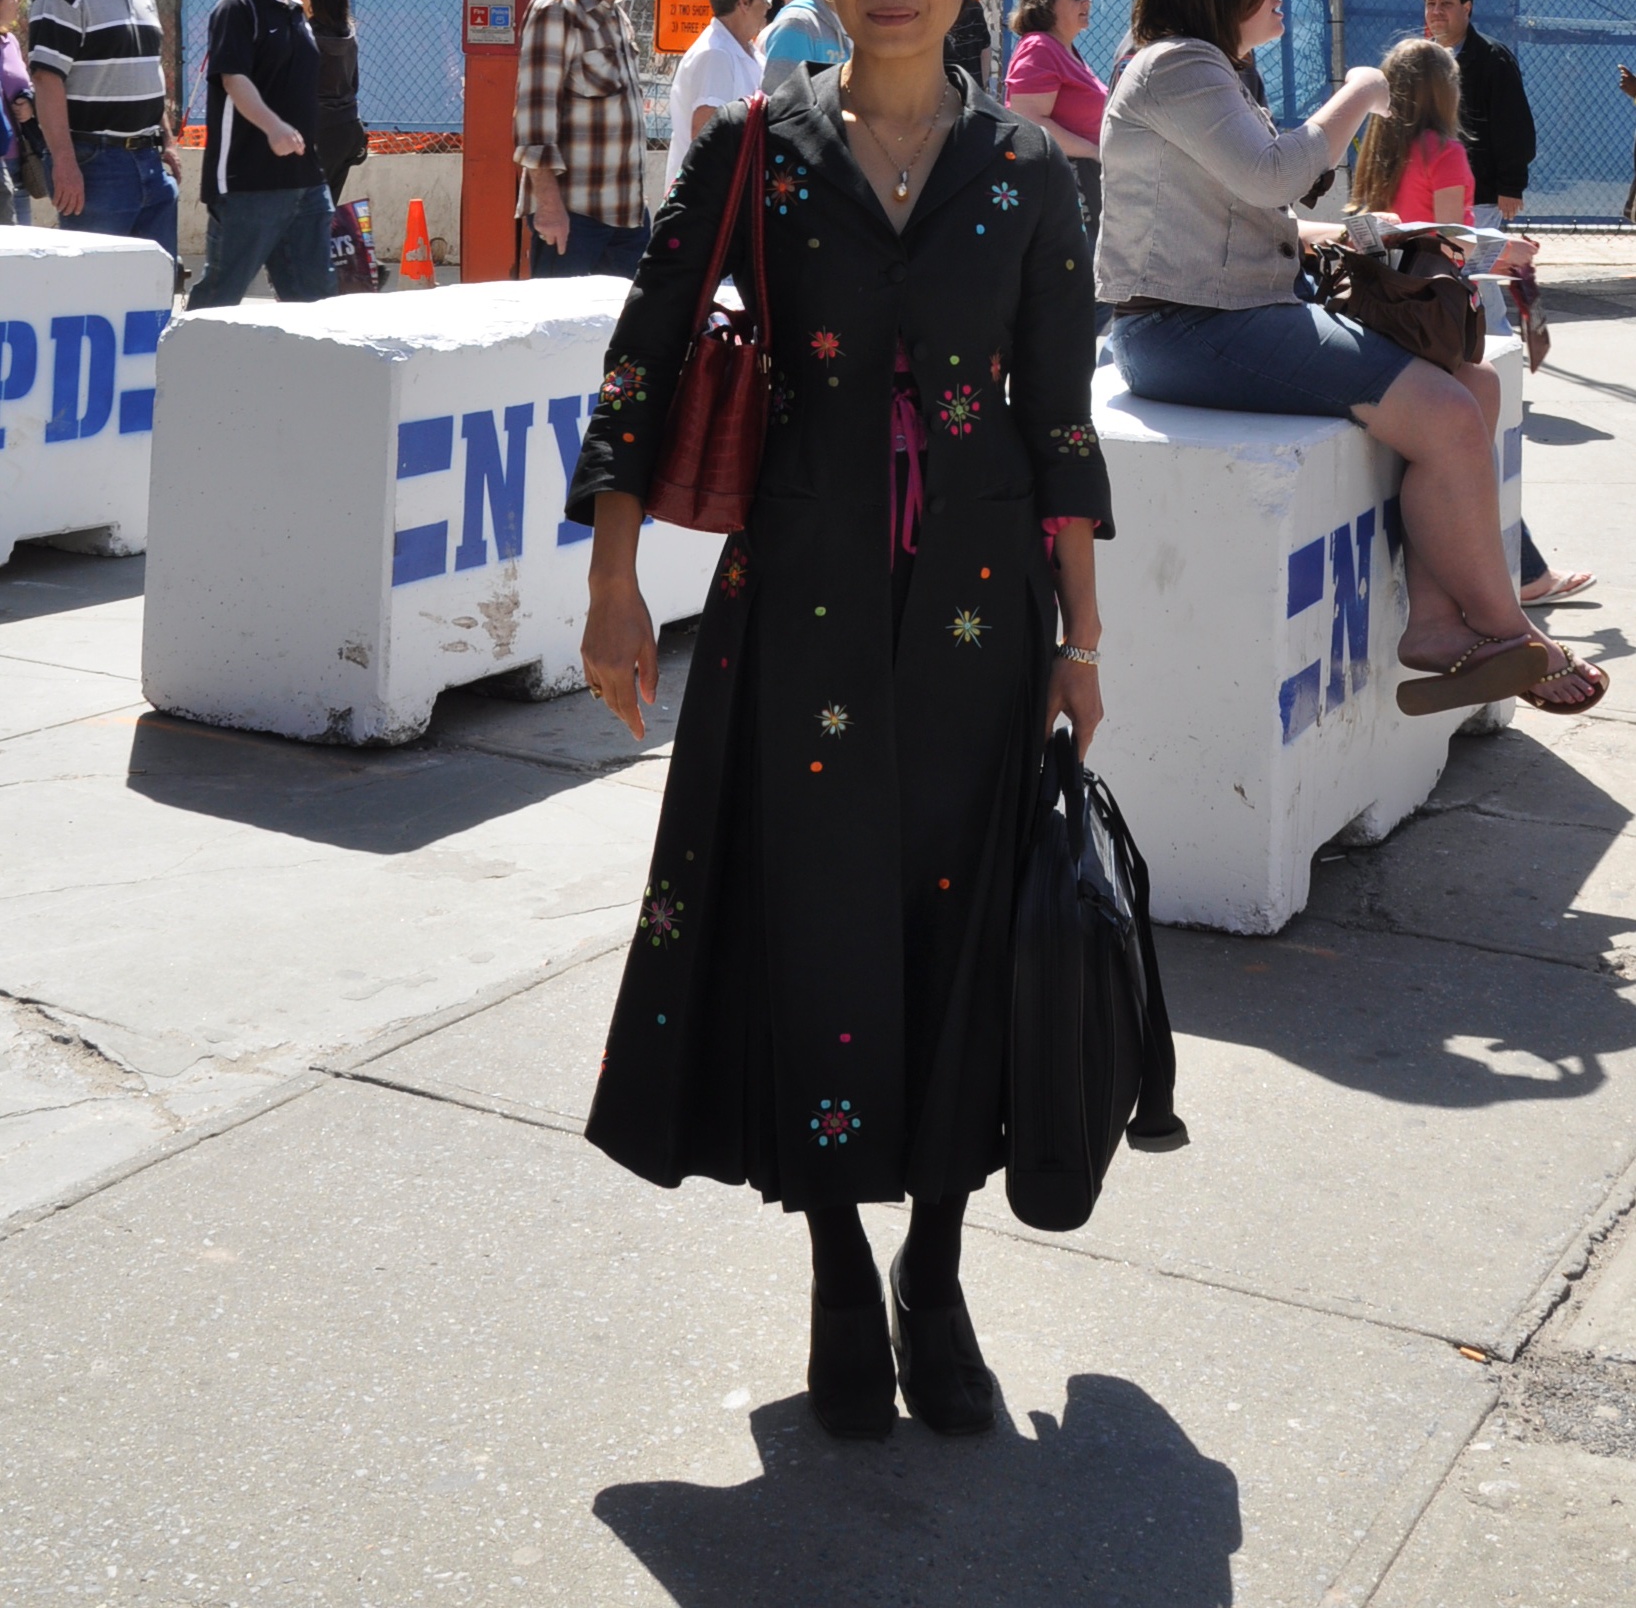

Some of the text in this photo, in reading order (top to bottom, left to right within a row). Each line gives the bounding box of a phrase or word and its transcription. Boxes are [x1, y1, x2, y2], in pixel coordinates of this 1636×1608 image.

[679, 4, 690, 16] TWO
[692, 5, 710, 16] SHORT
[681, 22, 699, 34] THREE
